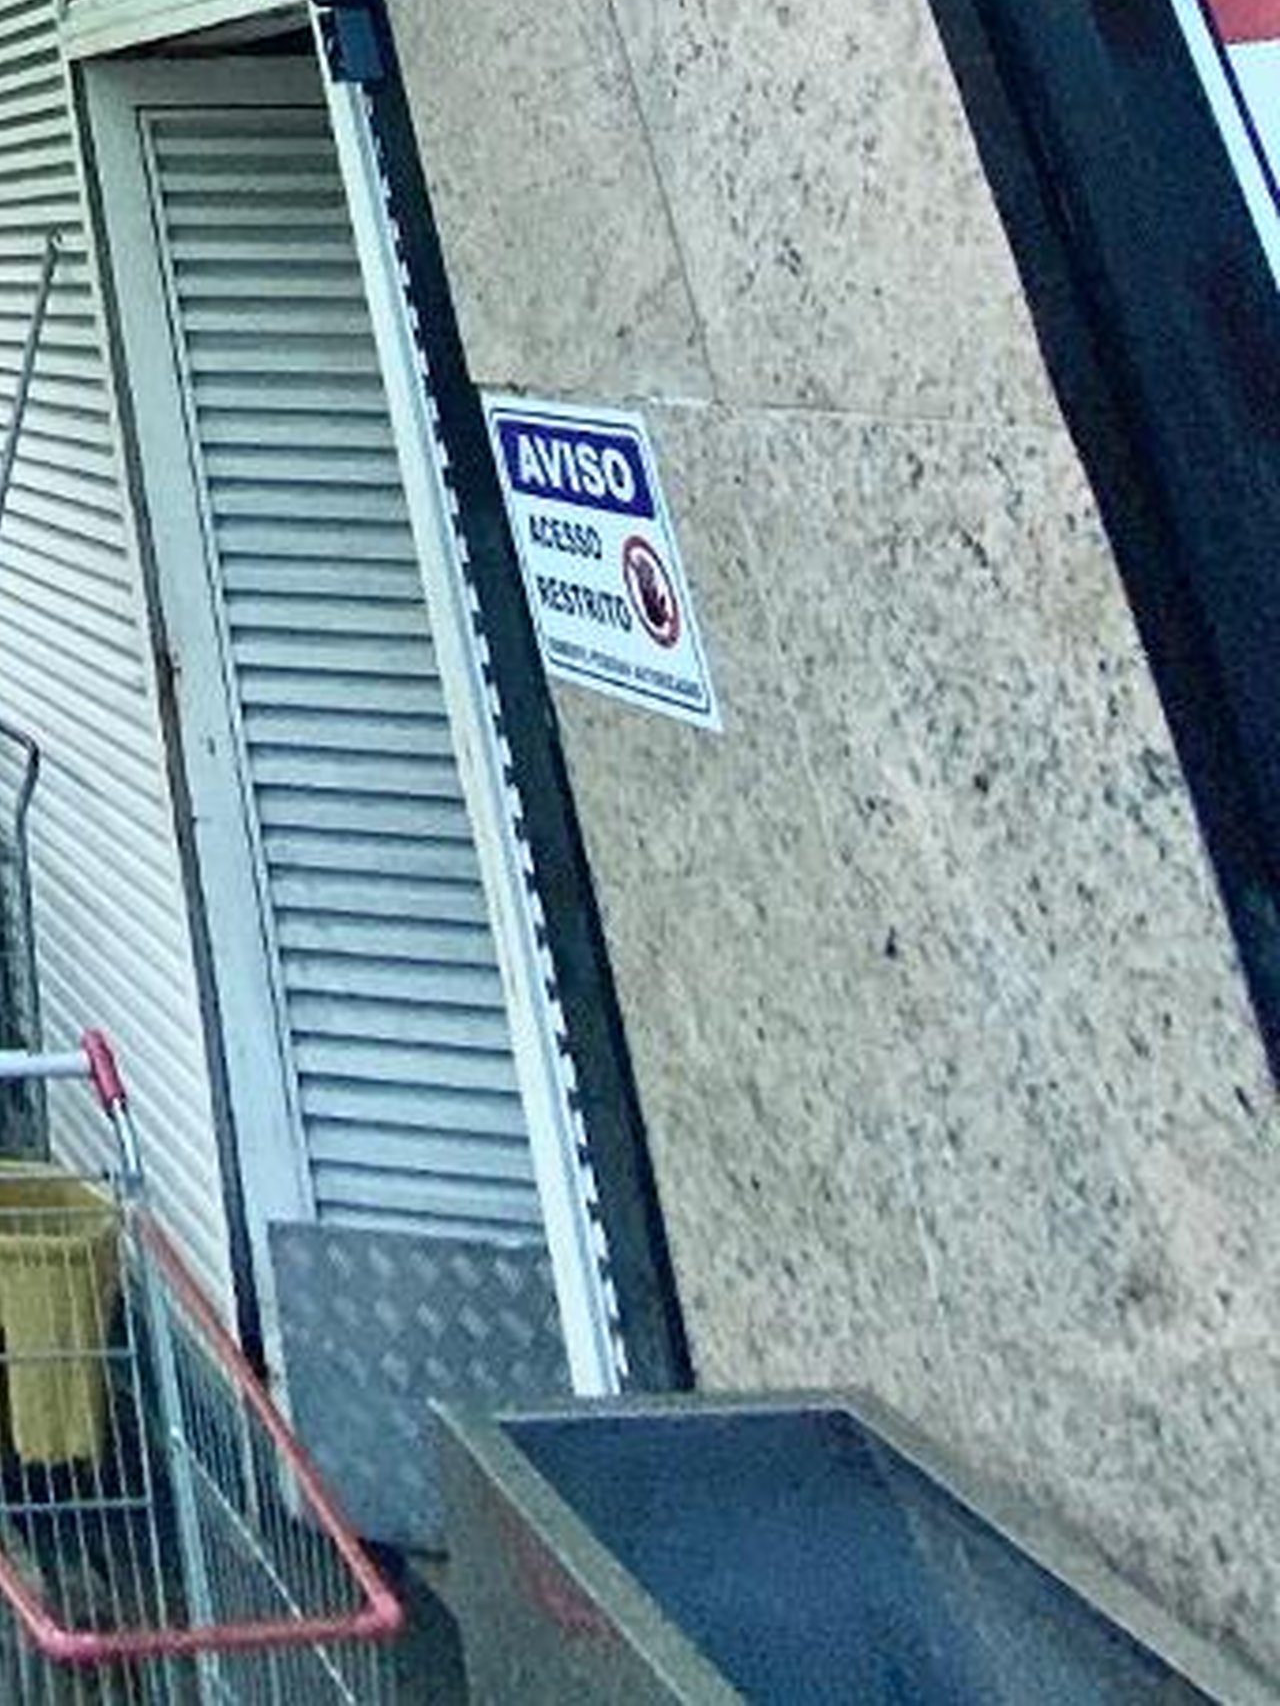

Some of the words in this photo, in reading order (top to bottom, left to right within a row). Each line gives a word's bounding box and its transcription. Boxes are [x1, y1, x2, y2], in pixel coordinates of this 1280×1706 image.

[517, 434, 636, 503] AVISO
[529, 514, 603, 561] ACESSO
[537, 575, 632, 633] RESTRITO
